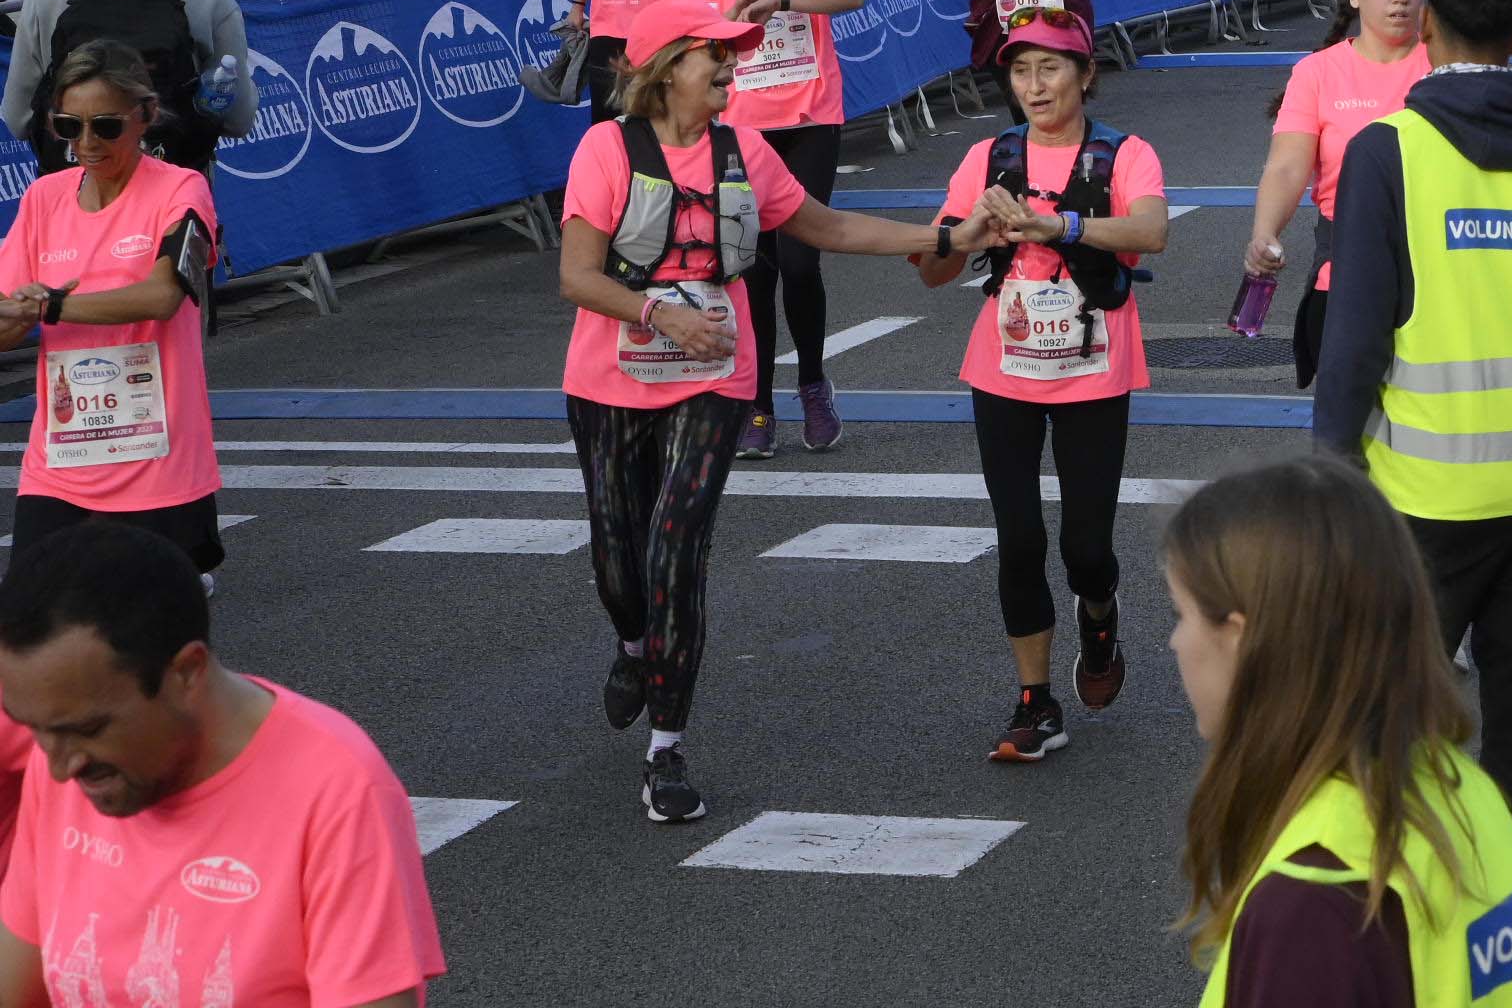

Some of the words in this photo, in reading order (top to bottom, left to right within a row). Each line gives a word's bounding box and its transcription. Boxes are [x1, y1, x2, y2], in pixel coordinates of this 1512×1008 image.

[439, 45, 471, 60] CENTRAL
[763, 53, 780, 62] 3021
[327, 67, 363, 85] CENTRAL
[367, 58, 401, 76] LECHERA
[429, 51, 520, 101] ASTURIANA
[315, 74, 417, 126] ASTURIANA
[1334, 98, 1378, 111] OYSHO
[1030, 297, 1071, 307] ASTURIANA
[1034, 319, 1070, 334] 016
[1038, 338, 1066, 347] 10927
[627, 366, 663, 376] OYSHO
[691, 364, 724, 374] Santander
[1011, 361, 1040, 371] OYSHO
[1067, 360, 1098, 369] Santander
[72, 369, 116, 380] ASTURIANA
[77, 393, 118, 411] 016
[83, 414, 114, 427] 10838
[57, 449, 87, 459] OYSHO
[118, 441, 158, 452] Santander
[186, 868, 253, 895] ASTURIANA
